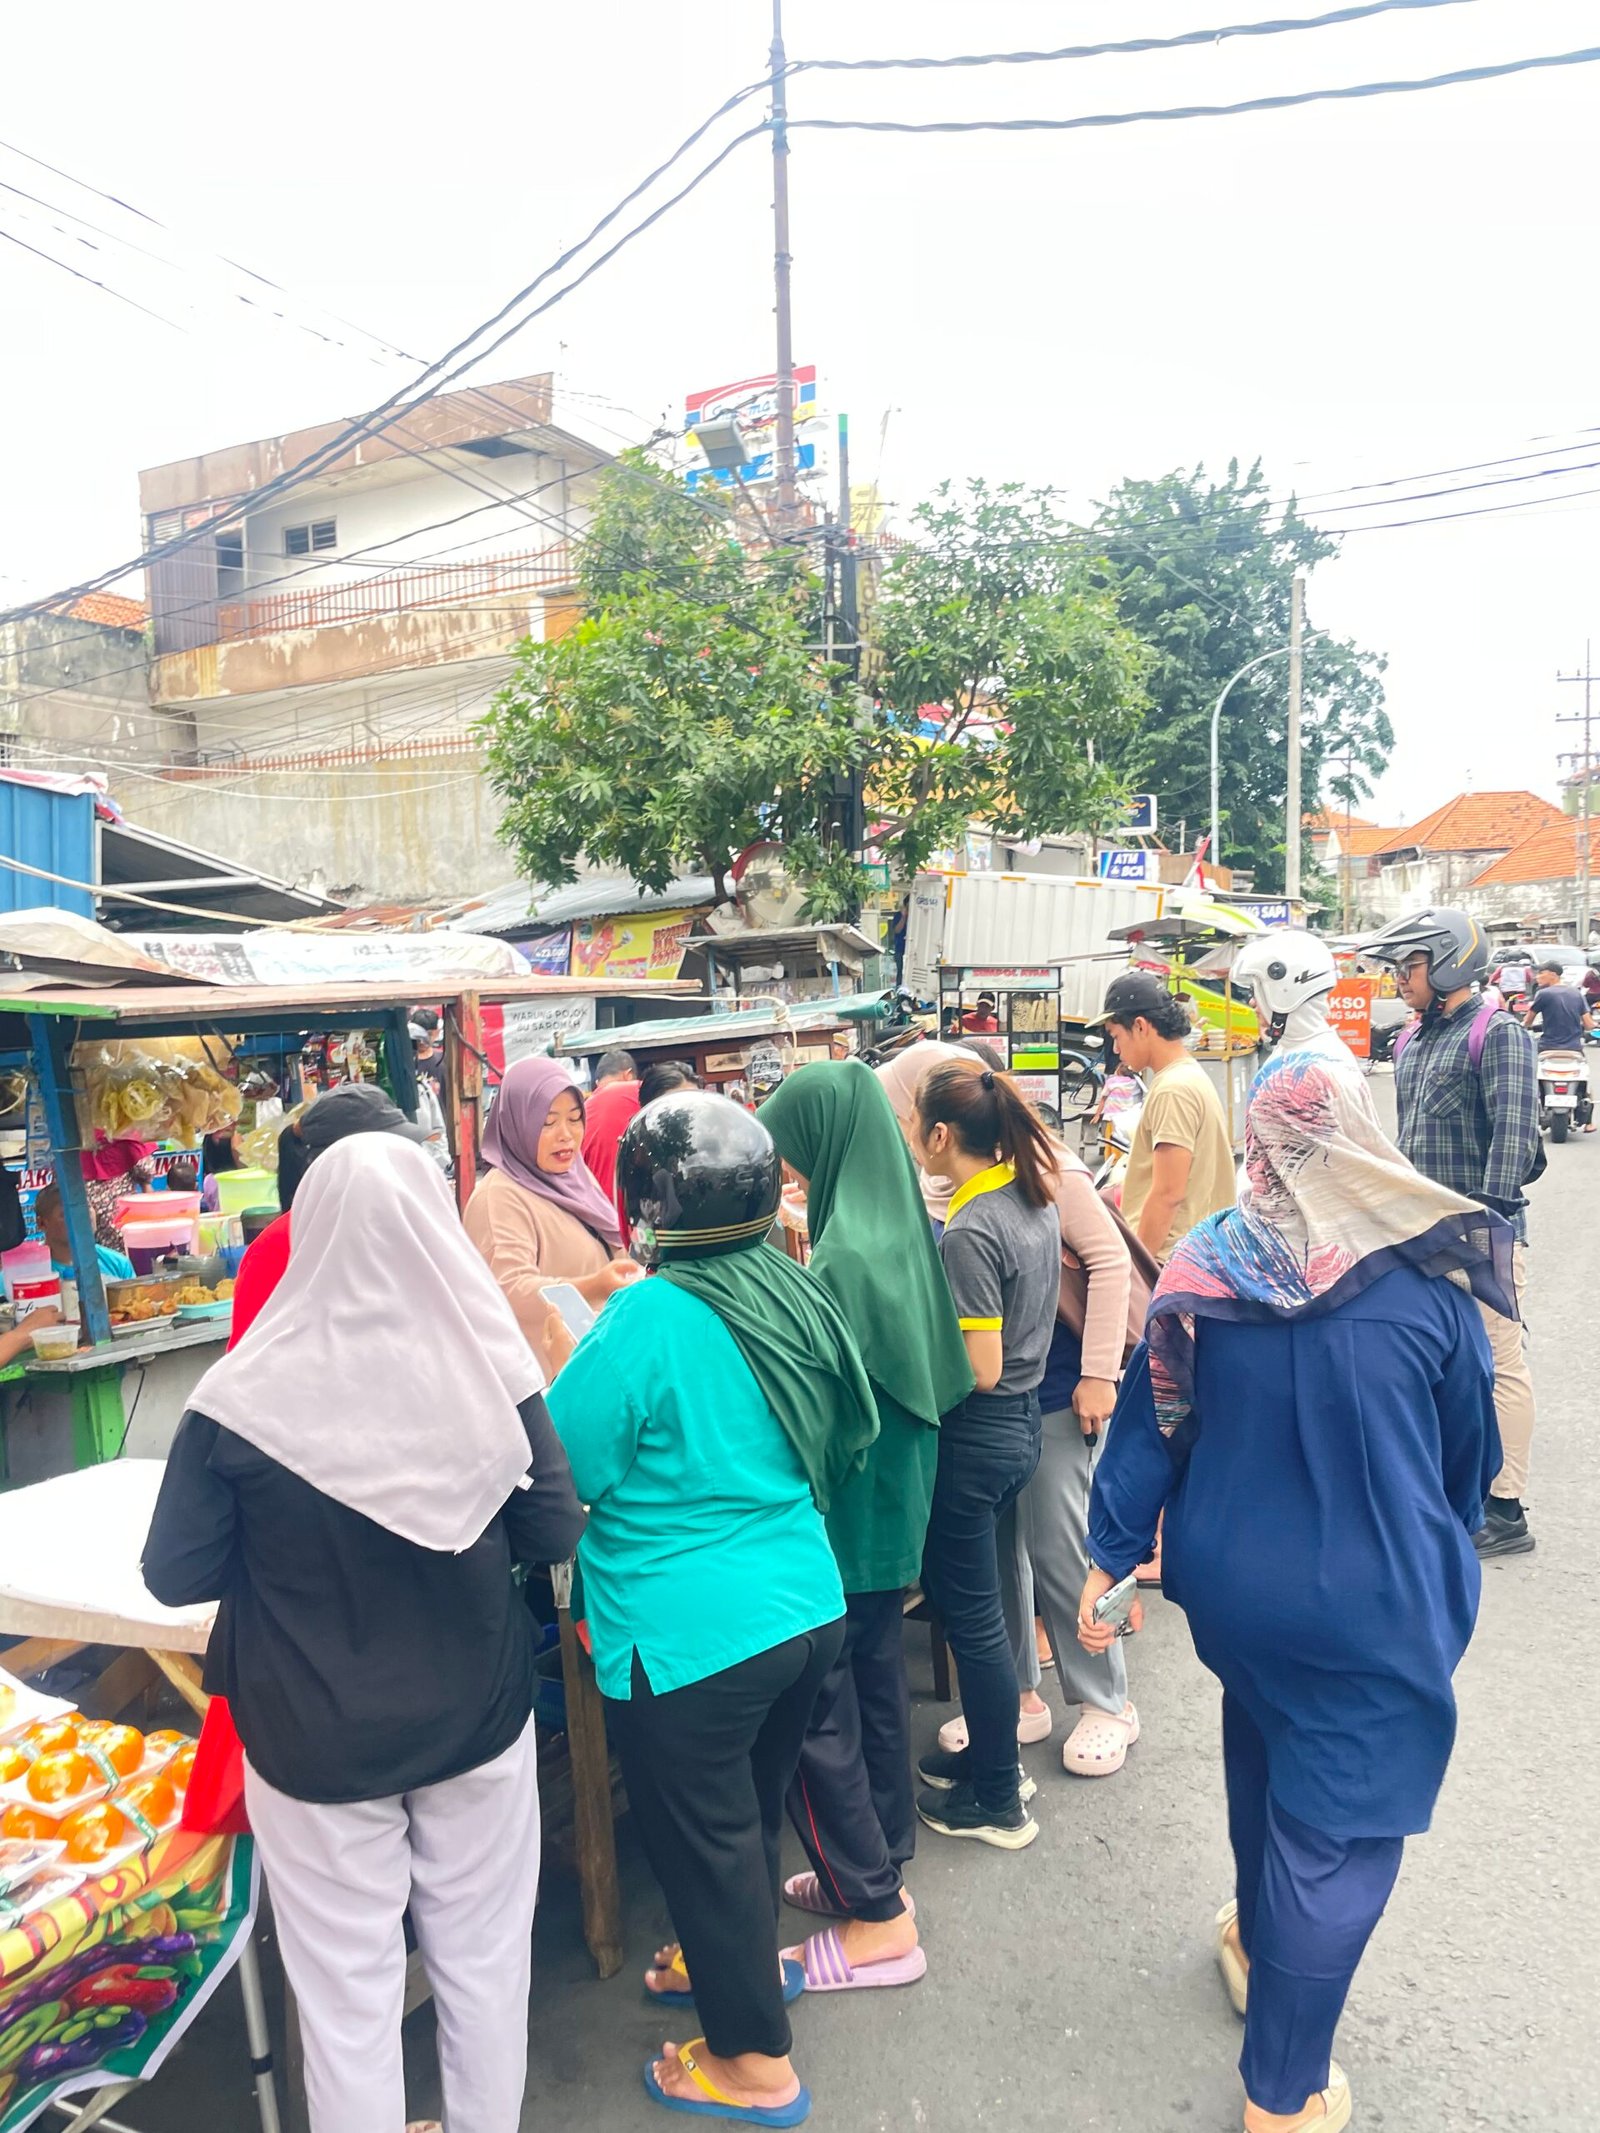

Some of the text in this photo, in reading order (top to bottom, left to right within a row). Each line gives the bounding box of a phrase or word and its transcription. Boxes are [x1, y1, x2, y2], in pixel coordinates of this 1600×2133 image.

[1114, 853, 1139, 864] ATM
[1121, 865, 1144, 877] BCA
[1261, 905, 1286, 918] SAPI
[1344, 1011, 1368, 1020] SAPI
